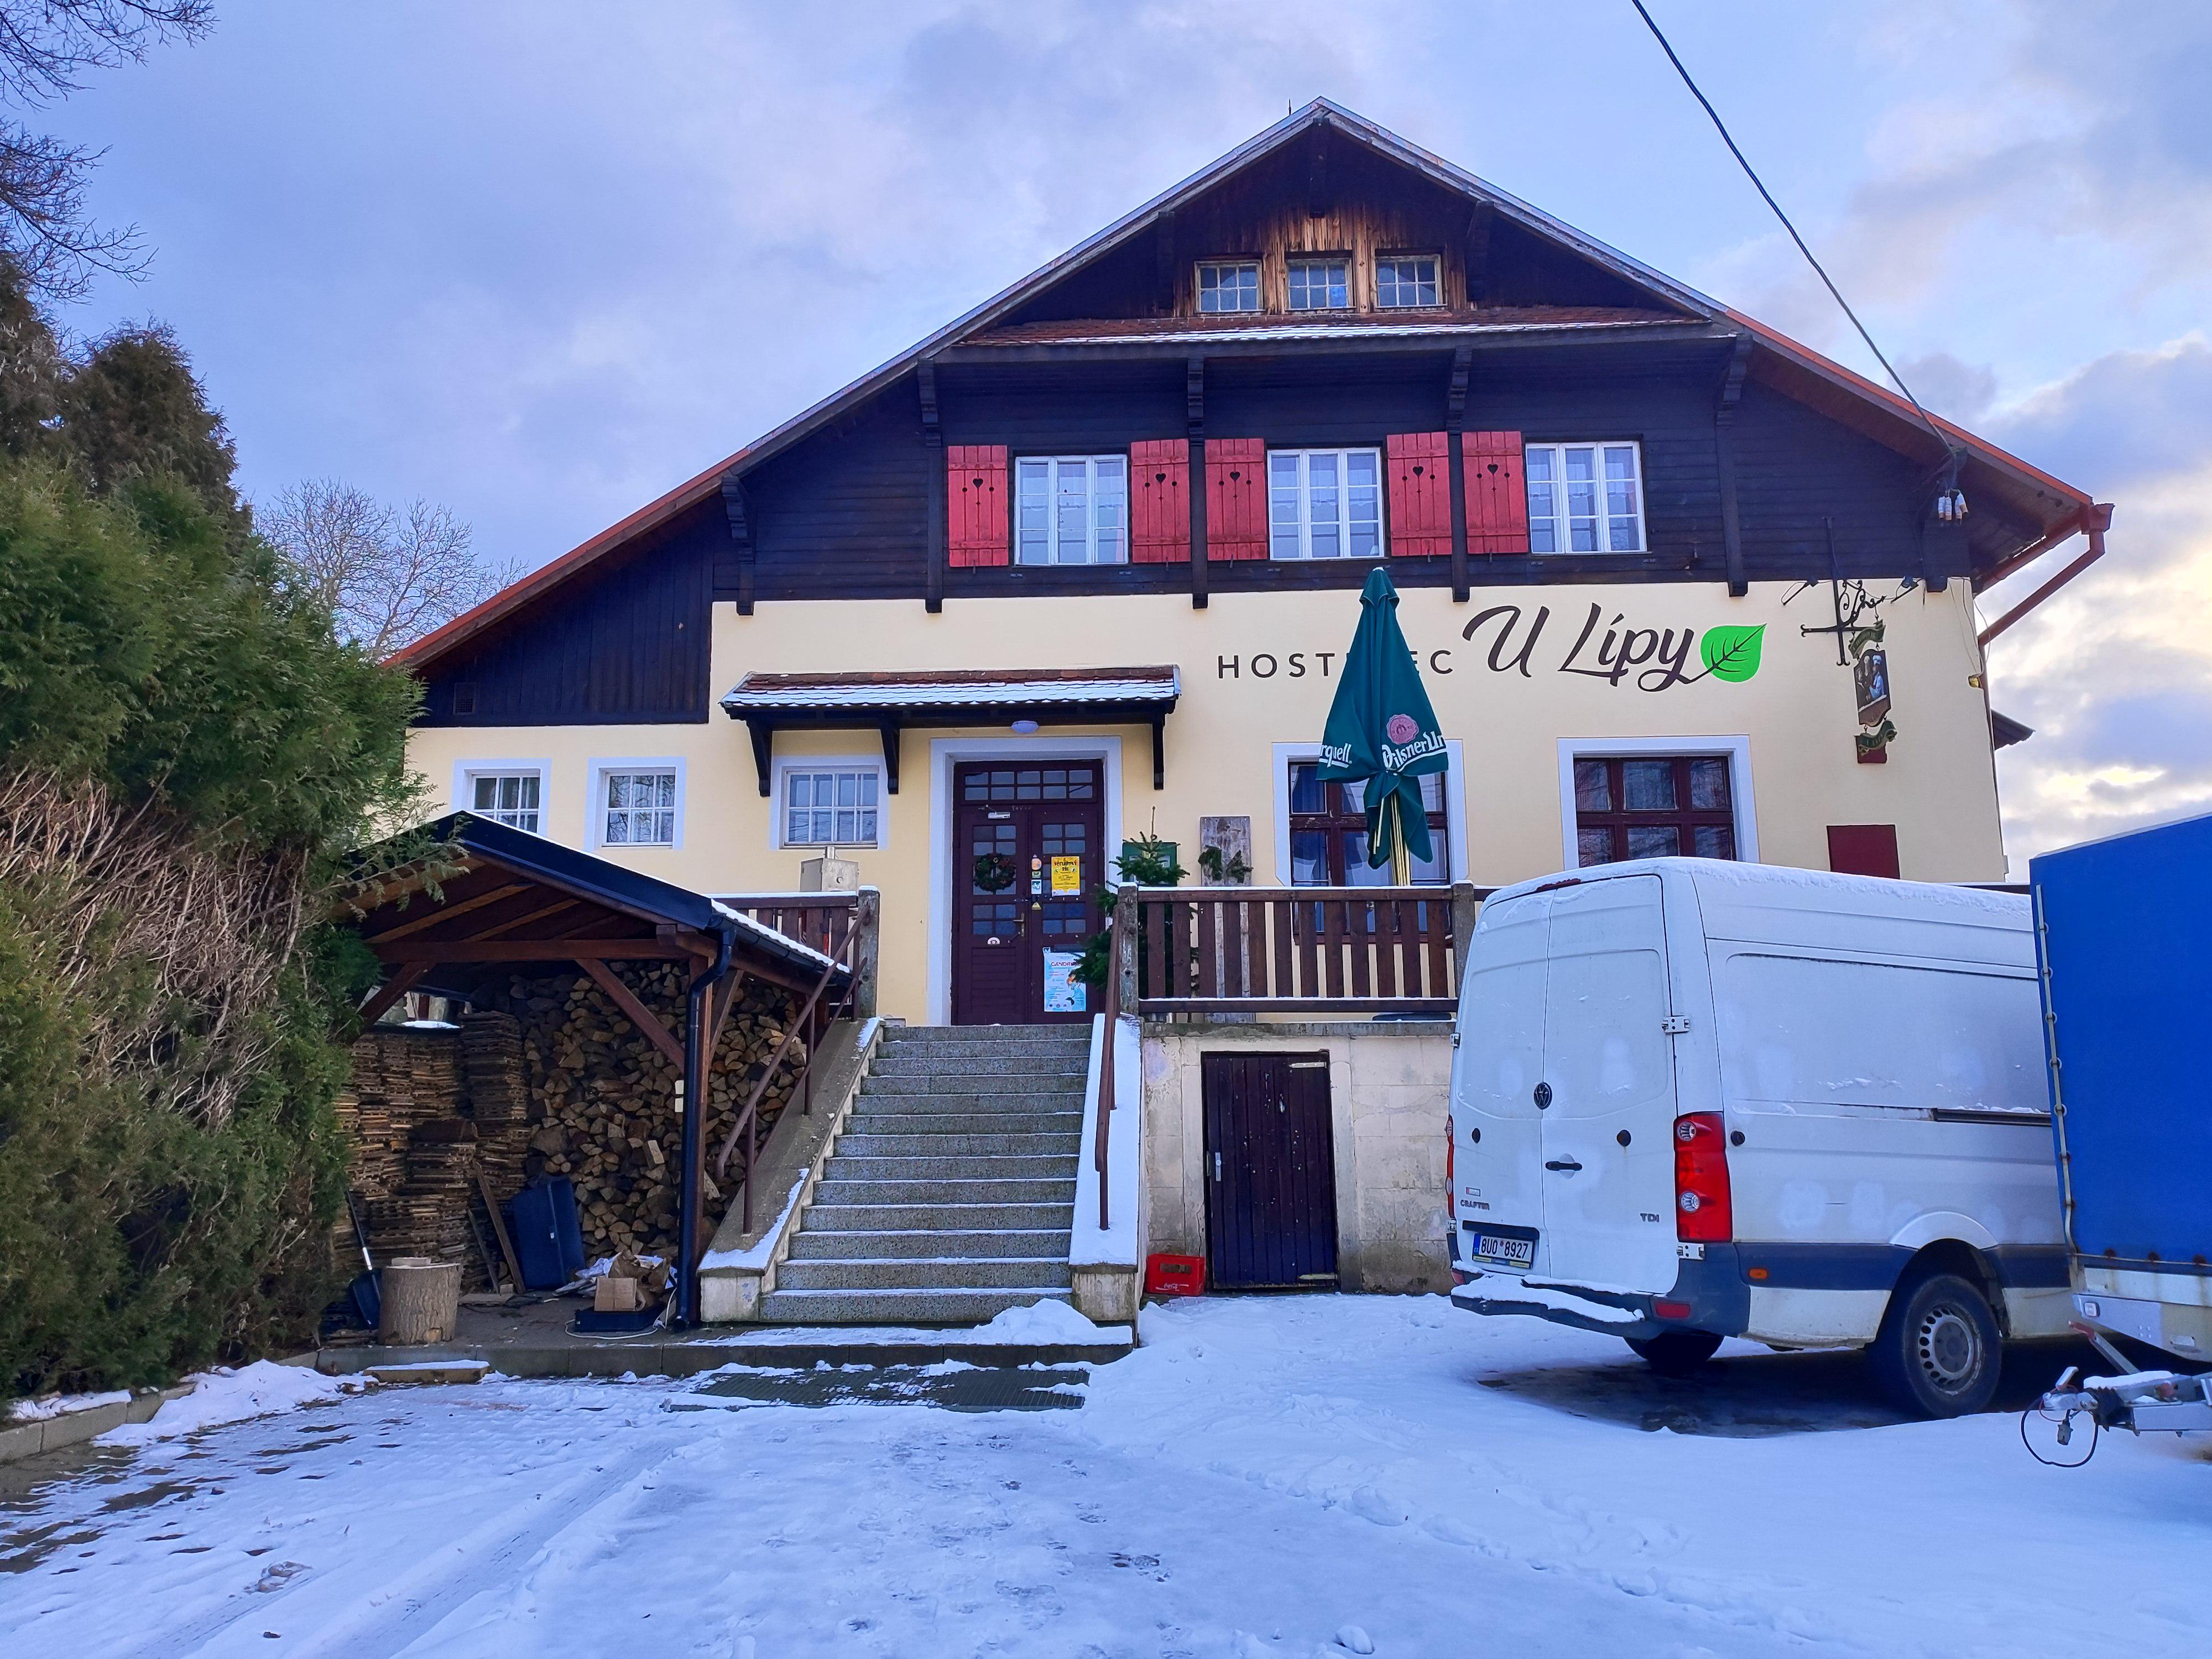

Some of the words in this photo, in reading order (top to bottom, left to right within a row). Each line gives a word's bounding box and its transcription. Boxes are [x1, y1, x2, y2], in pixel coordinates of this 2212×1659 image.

[1218, 650, 1453, 679] HOSTC
[1462, 605, 1550, 678] U
[1557, 602, 1703, 692] Lípy
[1320, 743, 1352, 768] rquell
[1382, 740, 1427, 769] Pilsner
[1460, 1199, 1490, 1211] CRAFTER
[1640, 1213, 1660, 1223] TDI
[1481, 1238, 1498, 1255] 8U0
[1504, 1241, 1528, 1259] 8927
